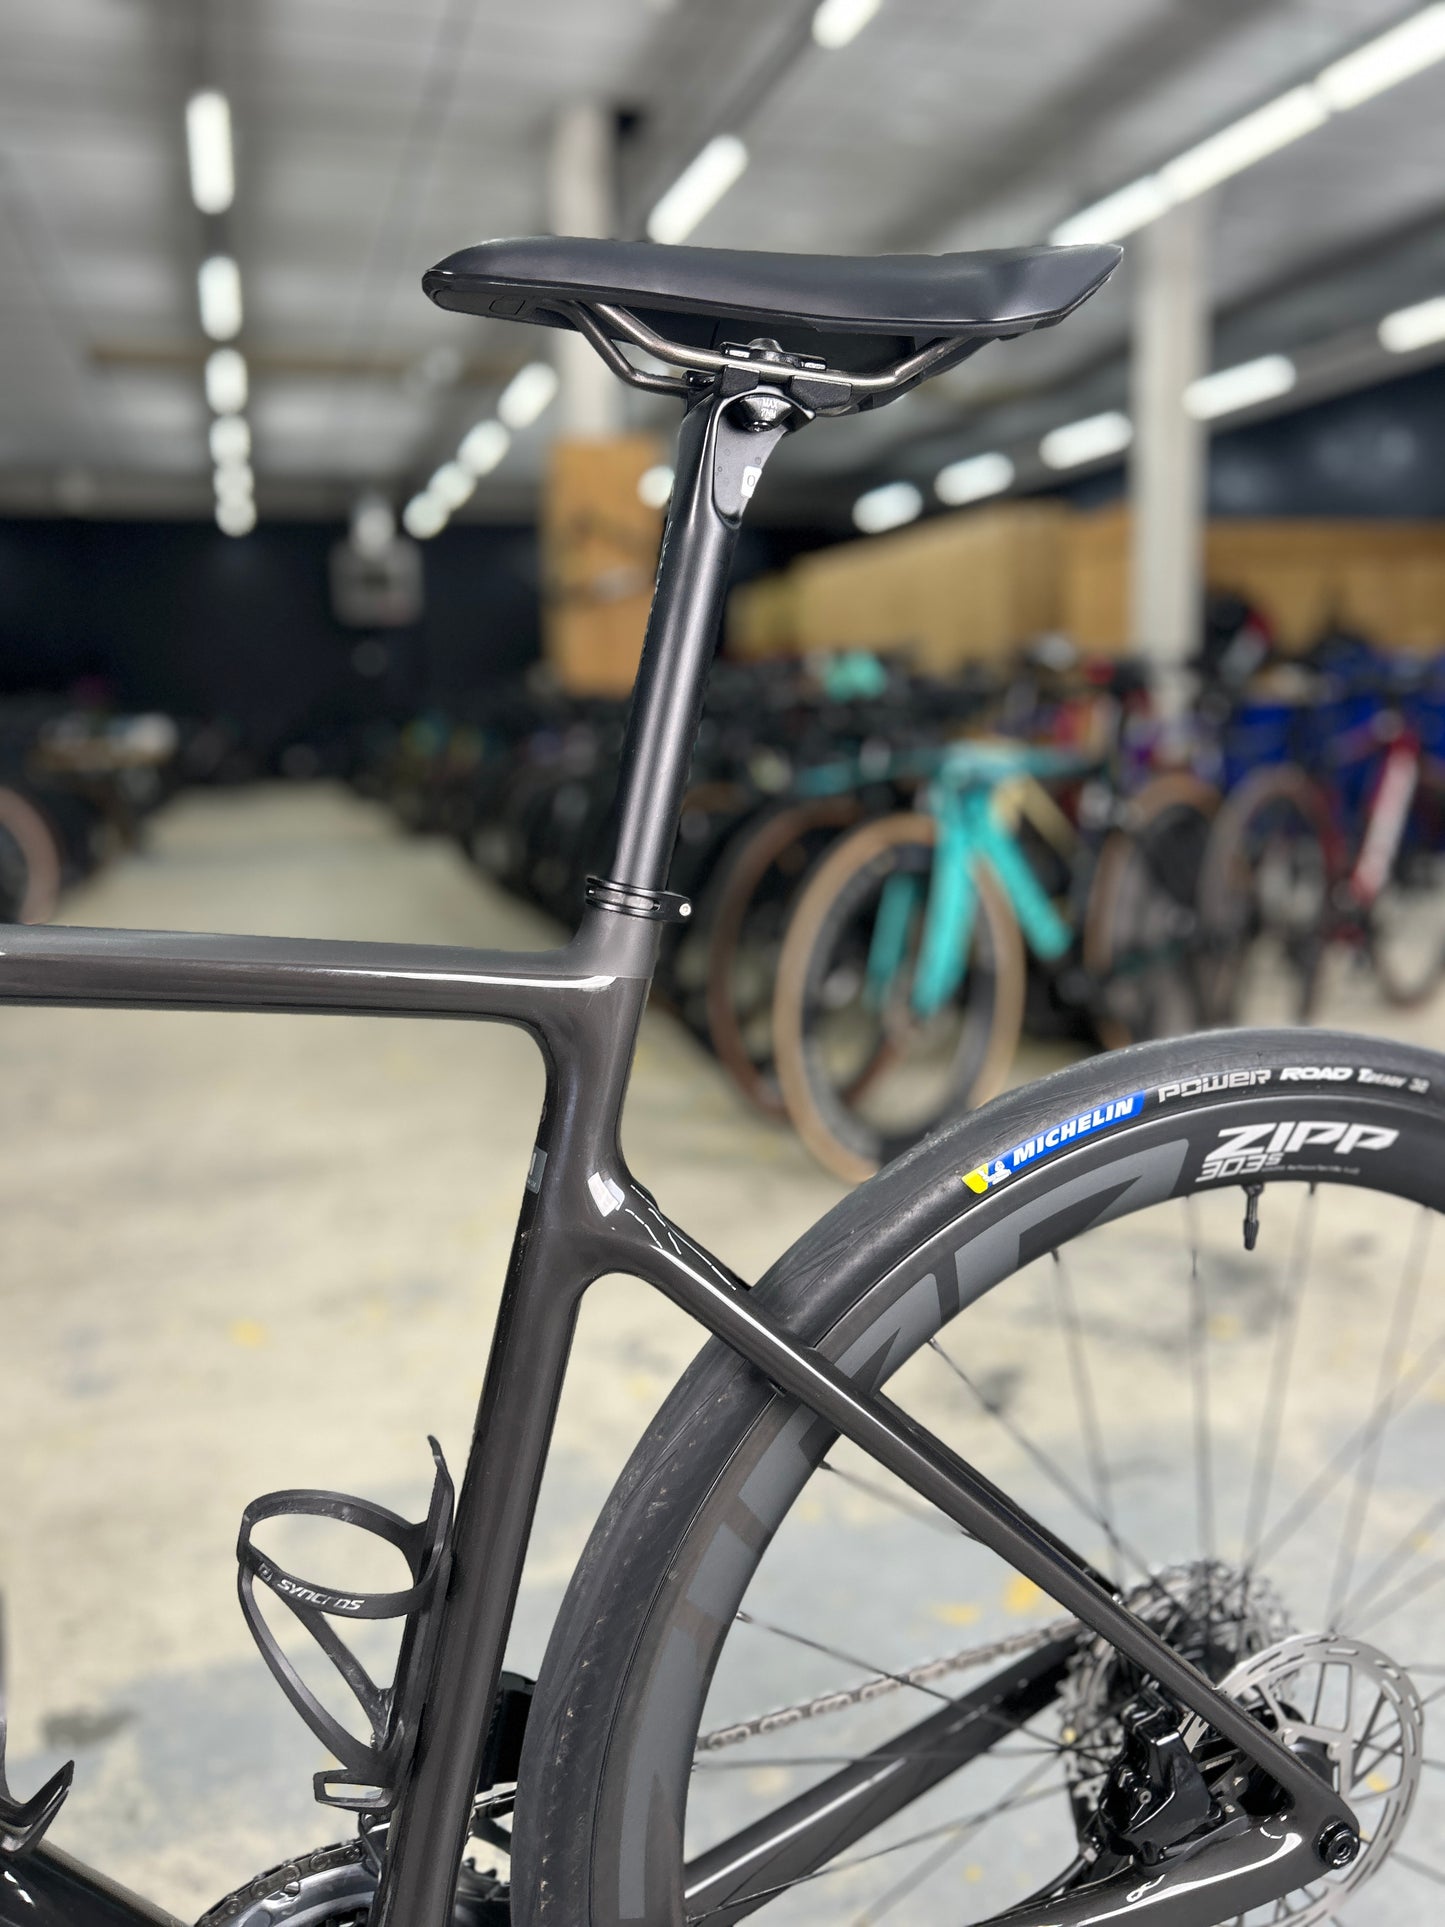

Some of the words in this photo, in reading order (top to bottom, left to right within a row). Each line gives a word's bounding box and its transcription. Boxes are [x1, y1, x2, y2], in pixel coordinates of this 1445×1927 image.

[762, 398, 778, 409] MAX
[1013, 1097, 1135, 1167] MICHELIN
[1158, 1069, 1272, 1104] POWER
[1279, 1066, 1354, 1082] ROAD
[1204, 1121, 1400, 1163] ZIPP
